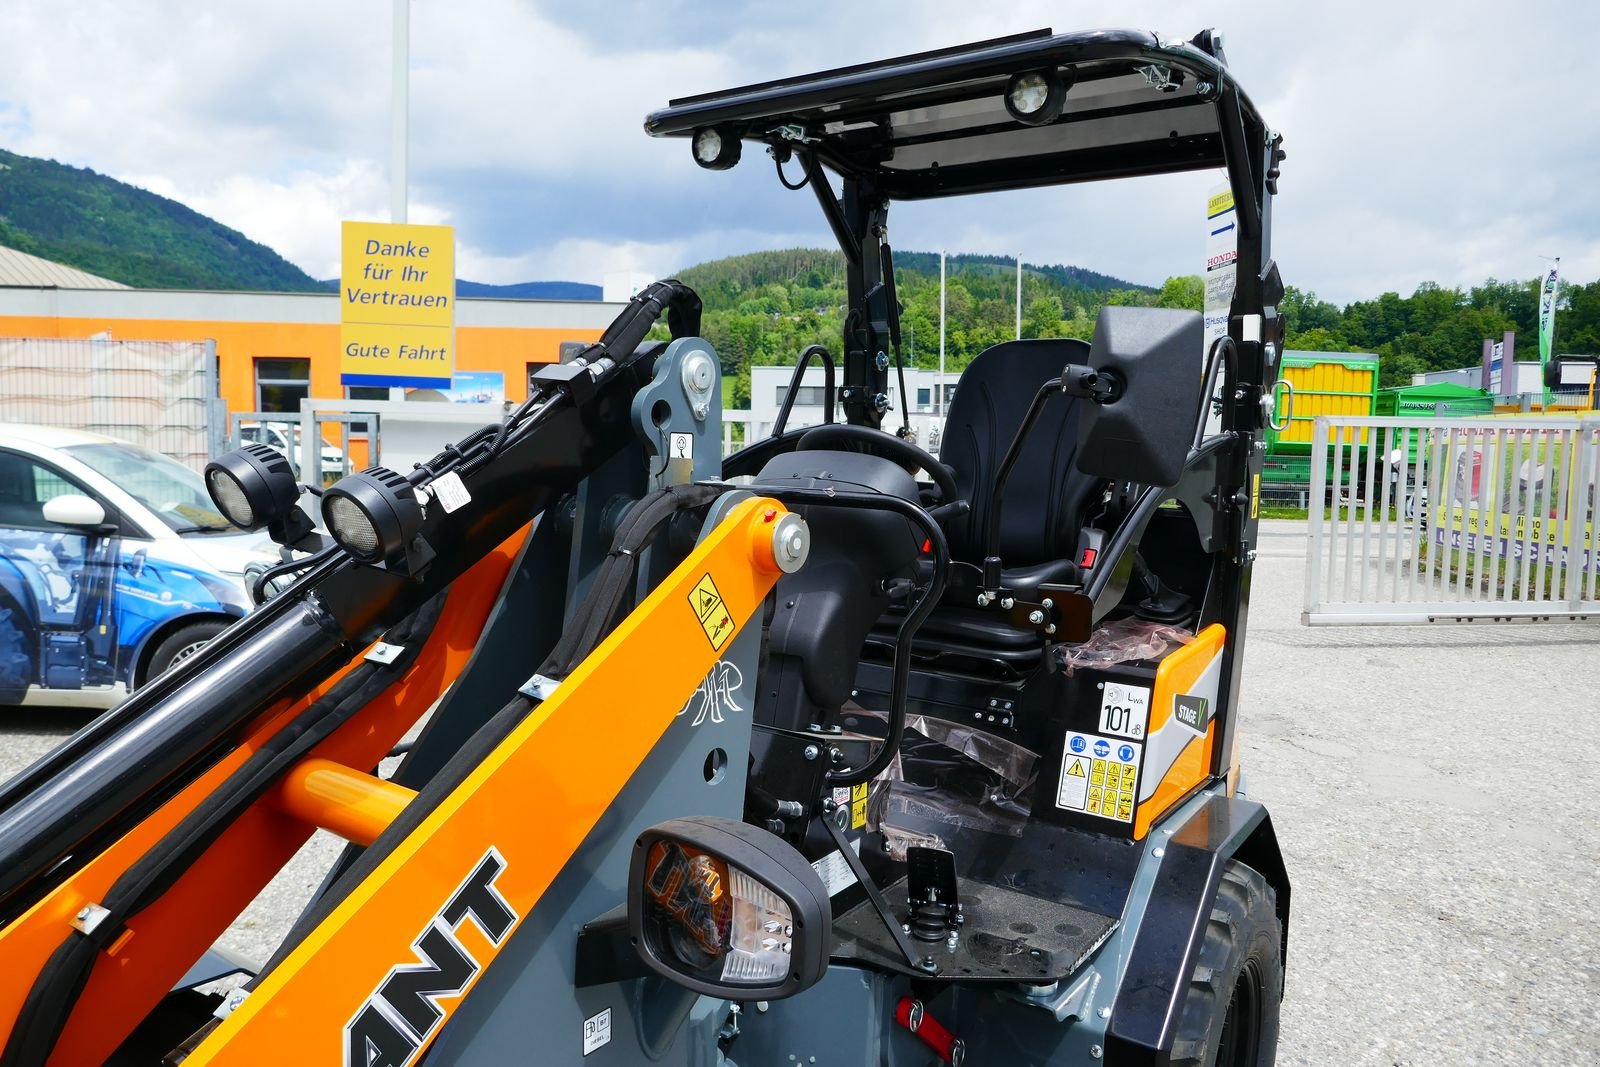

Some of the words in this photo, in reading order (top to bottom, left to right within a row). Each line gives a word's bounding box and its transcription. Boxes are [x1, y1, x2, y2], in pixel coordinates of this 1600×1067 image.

[365, 239, 430, 258] Danke
[1207, 250, 1238, 267] HONDA
[363, 262, 393, 281] für
[401, 265, 428, 282] Ihr
[347, 287, 448, 308] Vertrauen
[346, 342, 391, 359] Gute
[398, 345, 446, 361] Fahrt
[1105, 704, 1131, 733] 101
[1178, 704, 1197, 724] STAGE
[1131, 724, 1141, 735] dB
[343, 846, 519, 1067] ANT
